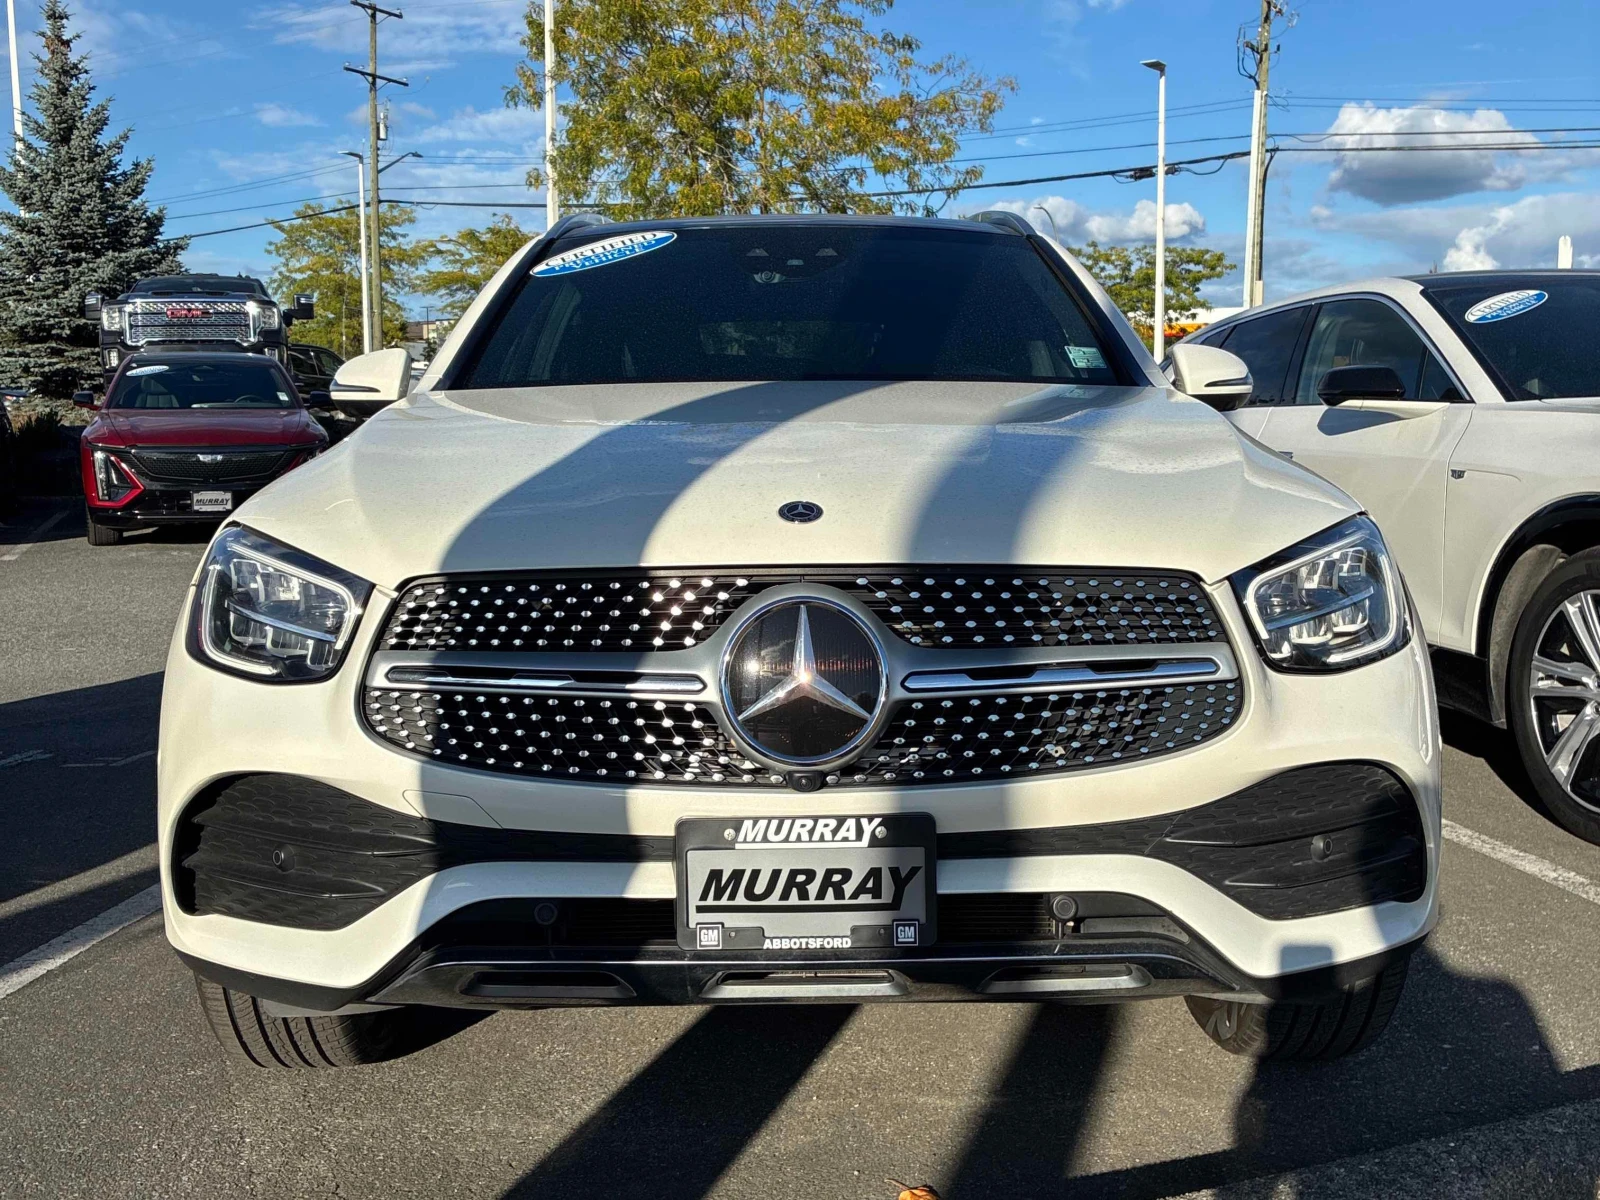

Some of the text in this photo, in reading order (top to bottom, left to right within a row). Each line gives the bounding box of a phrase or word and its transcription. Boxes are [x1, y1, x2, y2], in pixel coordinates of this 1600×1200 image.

[545, 232, 657, 268] CERTIFIED
[572, 244, 645, 269] VEHICLE
[166, 309, 213, 318] GMC
[1470, 291, 1531, 317] CERTIFIED
[736, 818, 883, 843] MURRAY
[698, 866, 923, 905] MURRAY
[700, 929, 719, 943] GM
[763, 938, 852, 949] ABBOTSFORD
[897, 926, 915, 940] GM
